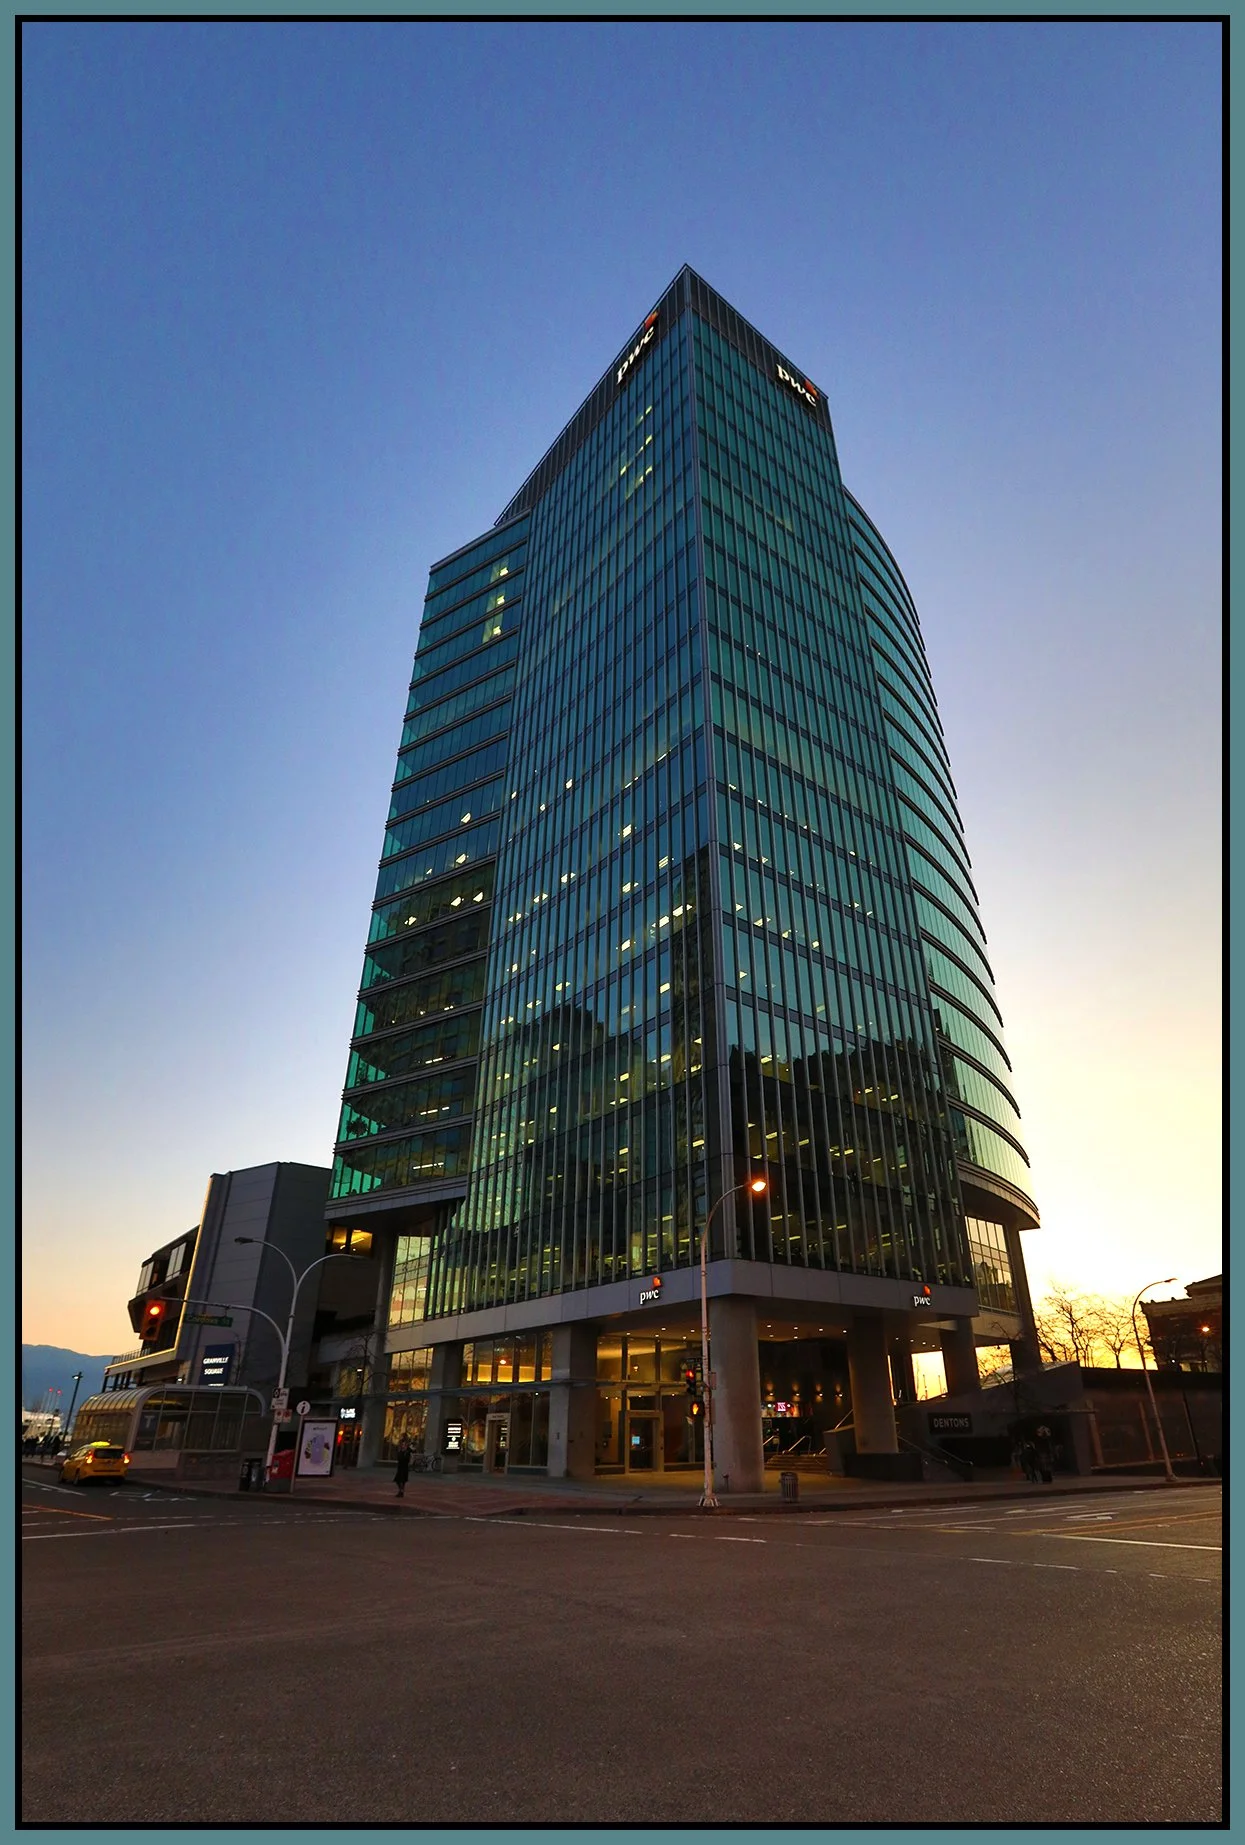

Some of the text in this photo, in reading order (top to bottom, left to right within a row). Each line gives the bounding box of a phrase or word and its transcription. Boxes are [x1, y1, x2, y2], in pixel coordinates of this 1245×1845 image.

[616, 326, 654, 385] pwc
[776, 363, 817, 407] pwc
[640, 1289, 659, 1305] pwc
[913, 1295, 931, 1307] pwc
[933, 1417, 969, 1428] DENTONS
